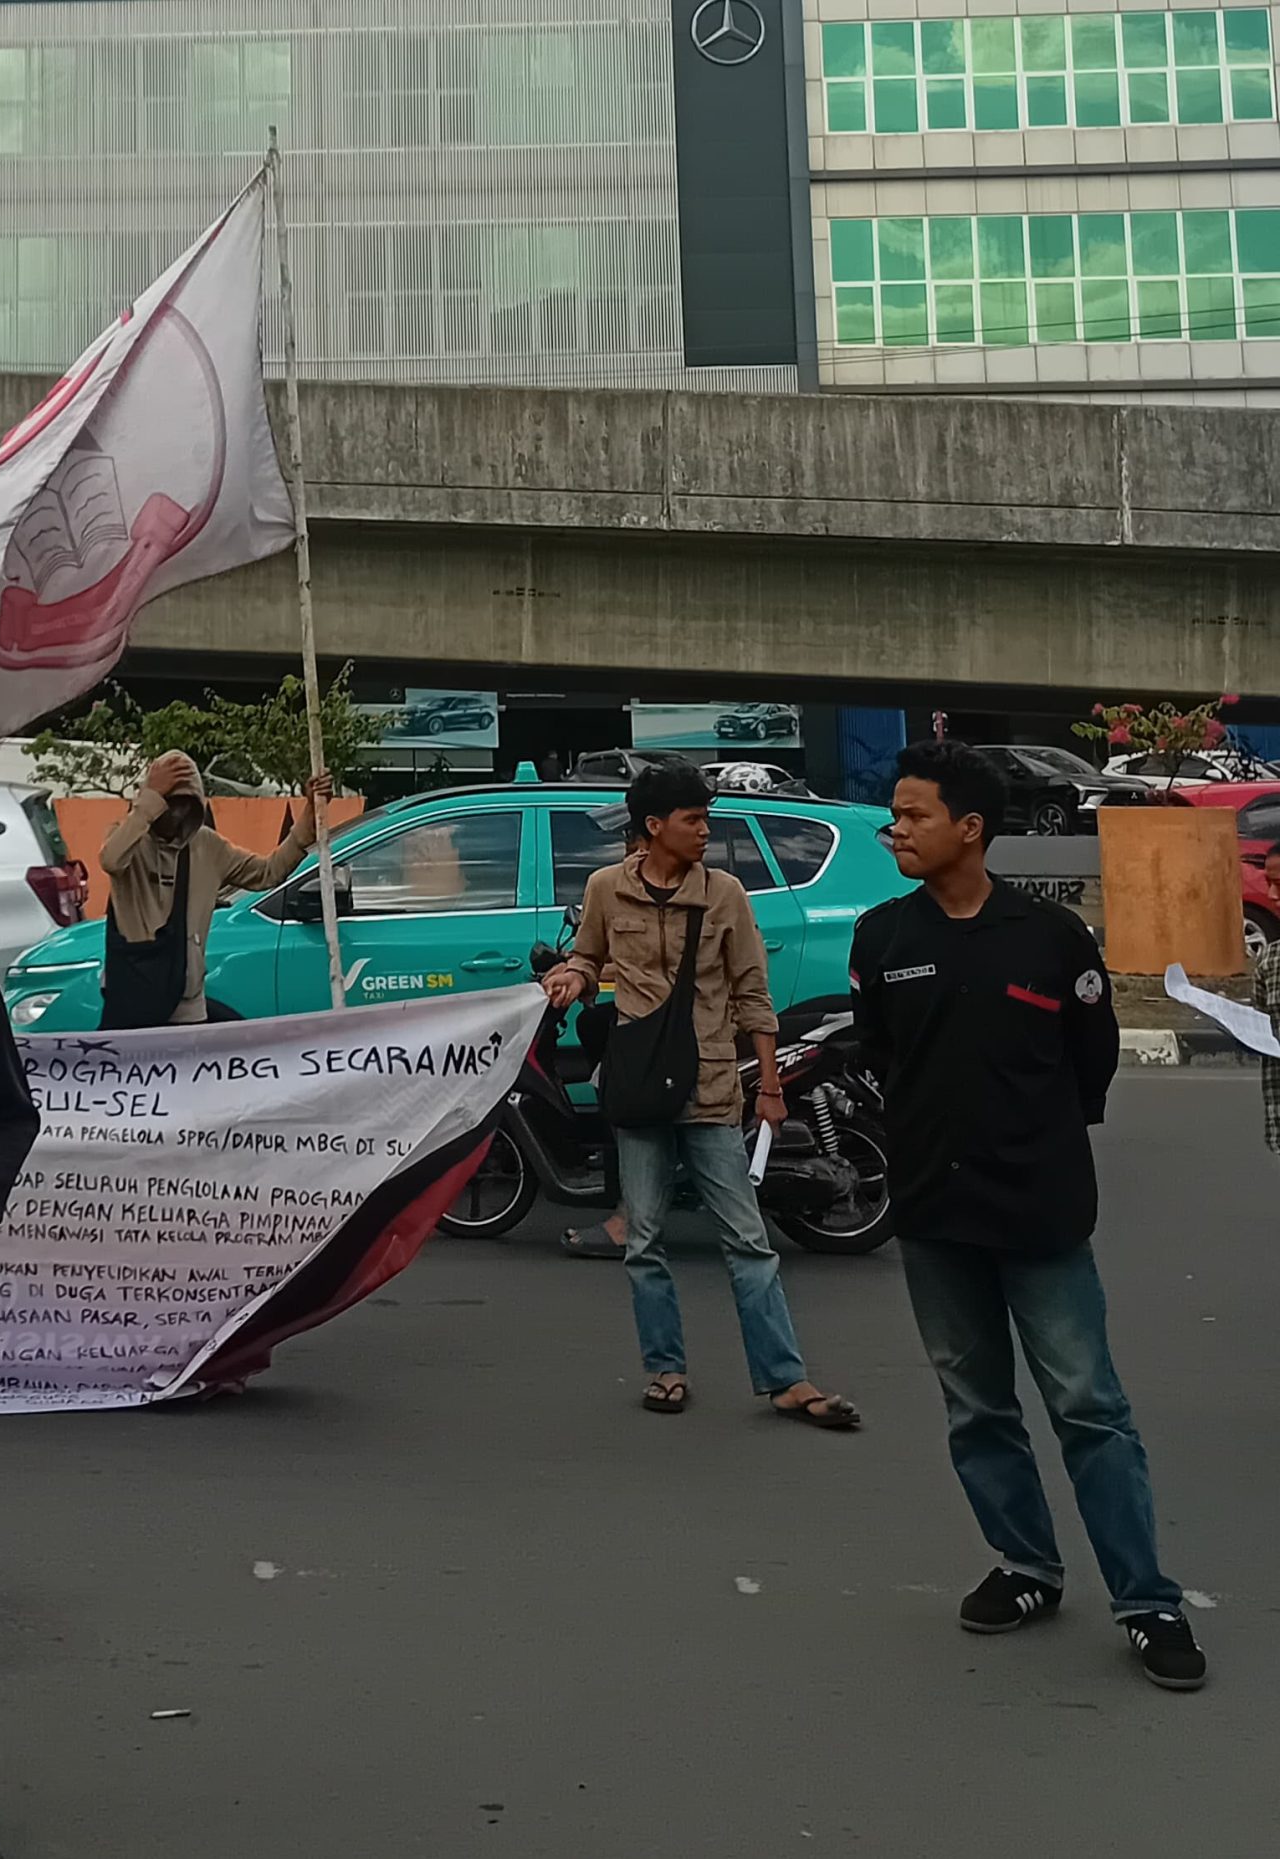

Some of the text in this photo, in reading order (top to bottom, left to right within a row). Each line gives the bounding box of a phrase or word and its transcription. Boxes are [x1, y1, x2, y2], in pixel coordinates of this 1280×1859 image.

[361, 973, 453, 991] GREEN SM
[192, 1057, 280, 1083] MBG
[299, 1045, 436, 1077] SECARA
[30, 1089, 169, 1118] SUL-SEL
[42, 1124, 74, 1139] ATA
[81, 1125, 165, 1145] PENGELOLA
[296, 1133, 348, 1155] MBG
[356, 1137, 375, 1156] DI
[54, 1172, 138, 1194] SELURUH
[25, 1200, 114, 1222] DENGAN
[122, 1202, 230, 1229] KELUARGA
[239, 1211, 333, 1234] PIMPINAN
[8, 1224, 104, 1244] MENGAWASI
[114, 1228, 151, 1244] TATA
[157, 1229, 208, 1245] KELOLA
[215, 1231, 293, 1247] PROGRAM
[53, 1264, 176, 1282] PENYELIDIKAN
[187, 1267, 228, 1282] AWAL
[29, 1283, 44, 1298] DI
[55, 1284, 106, 1301] DUGA
